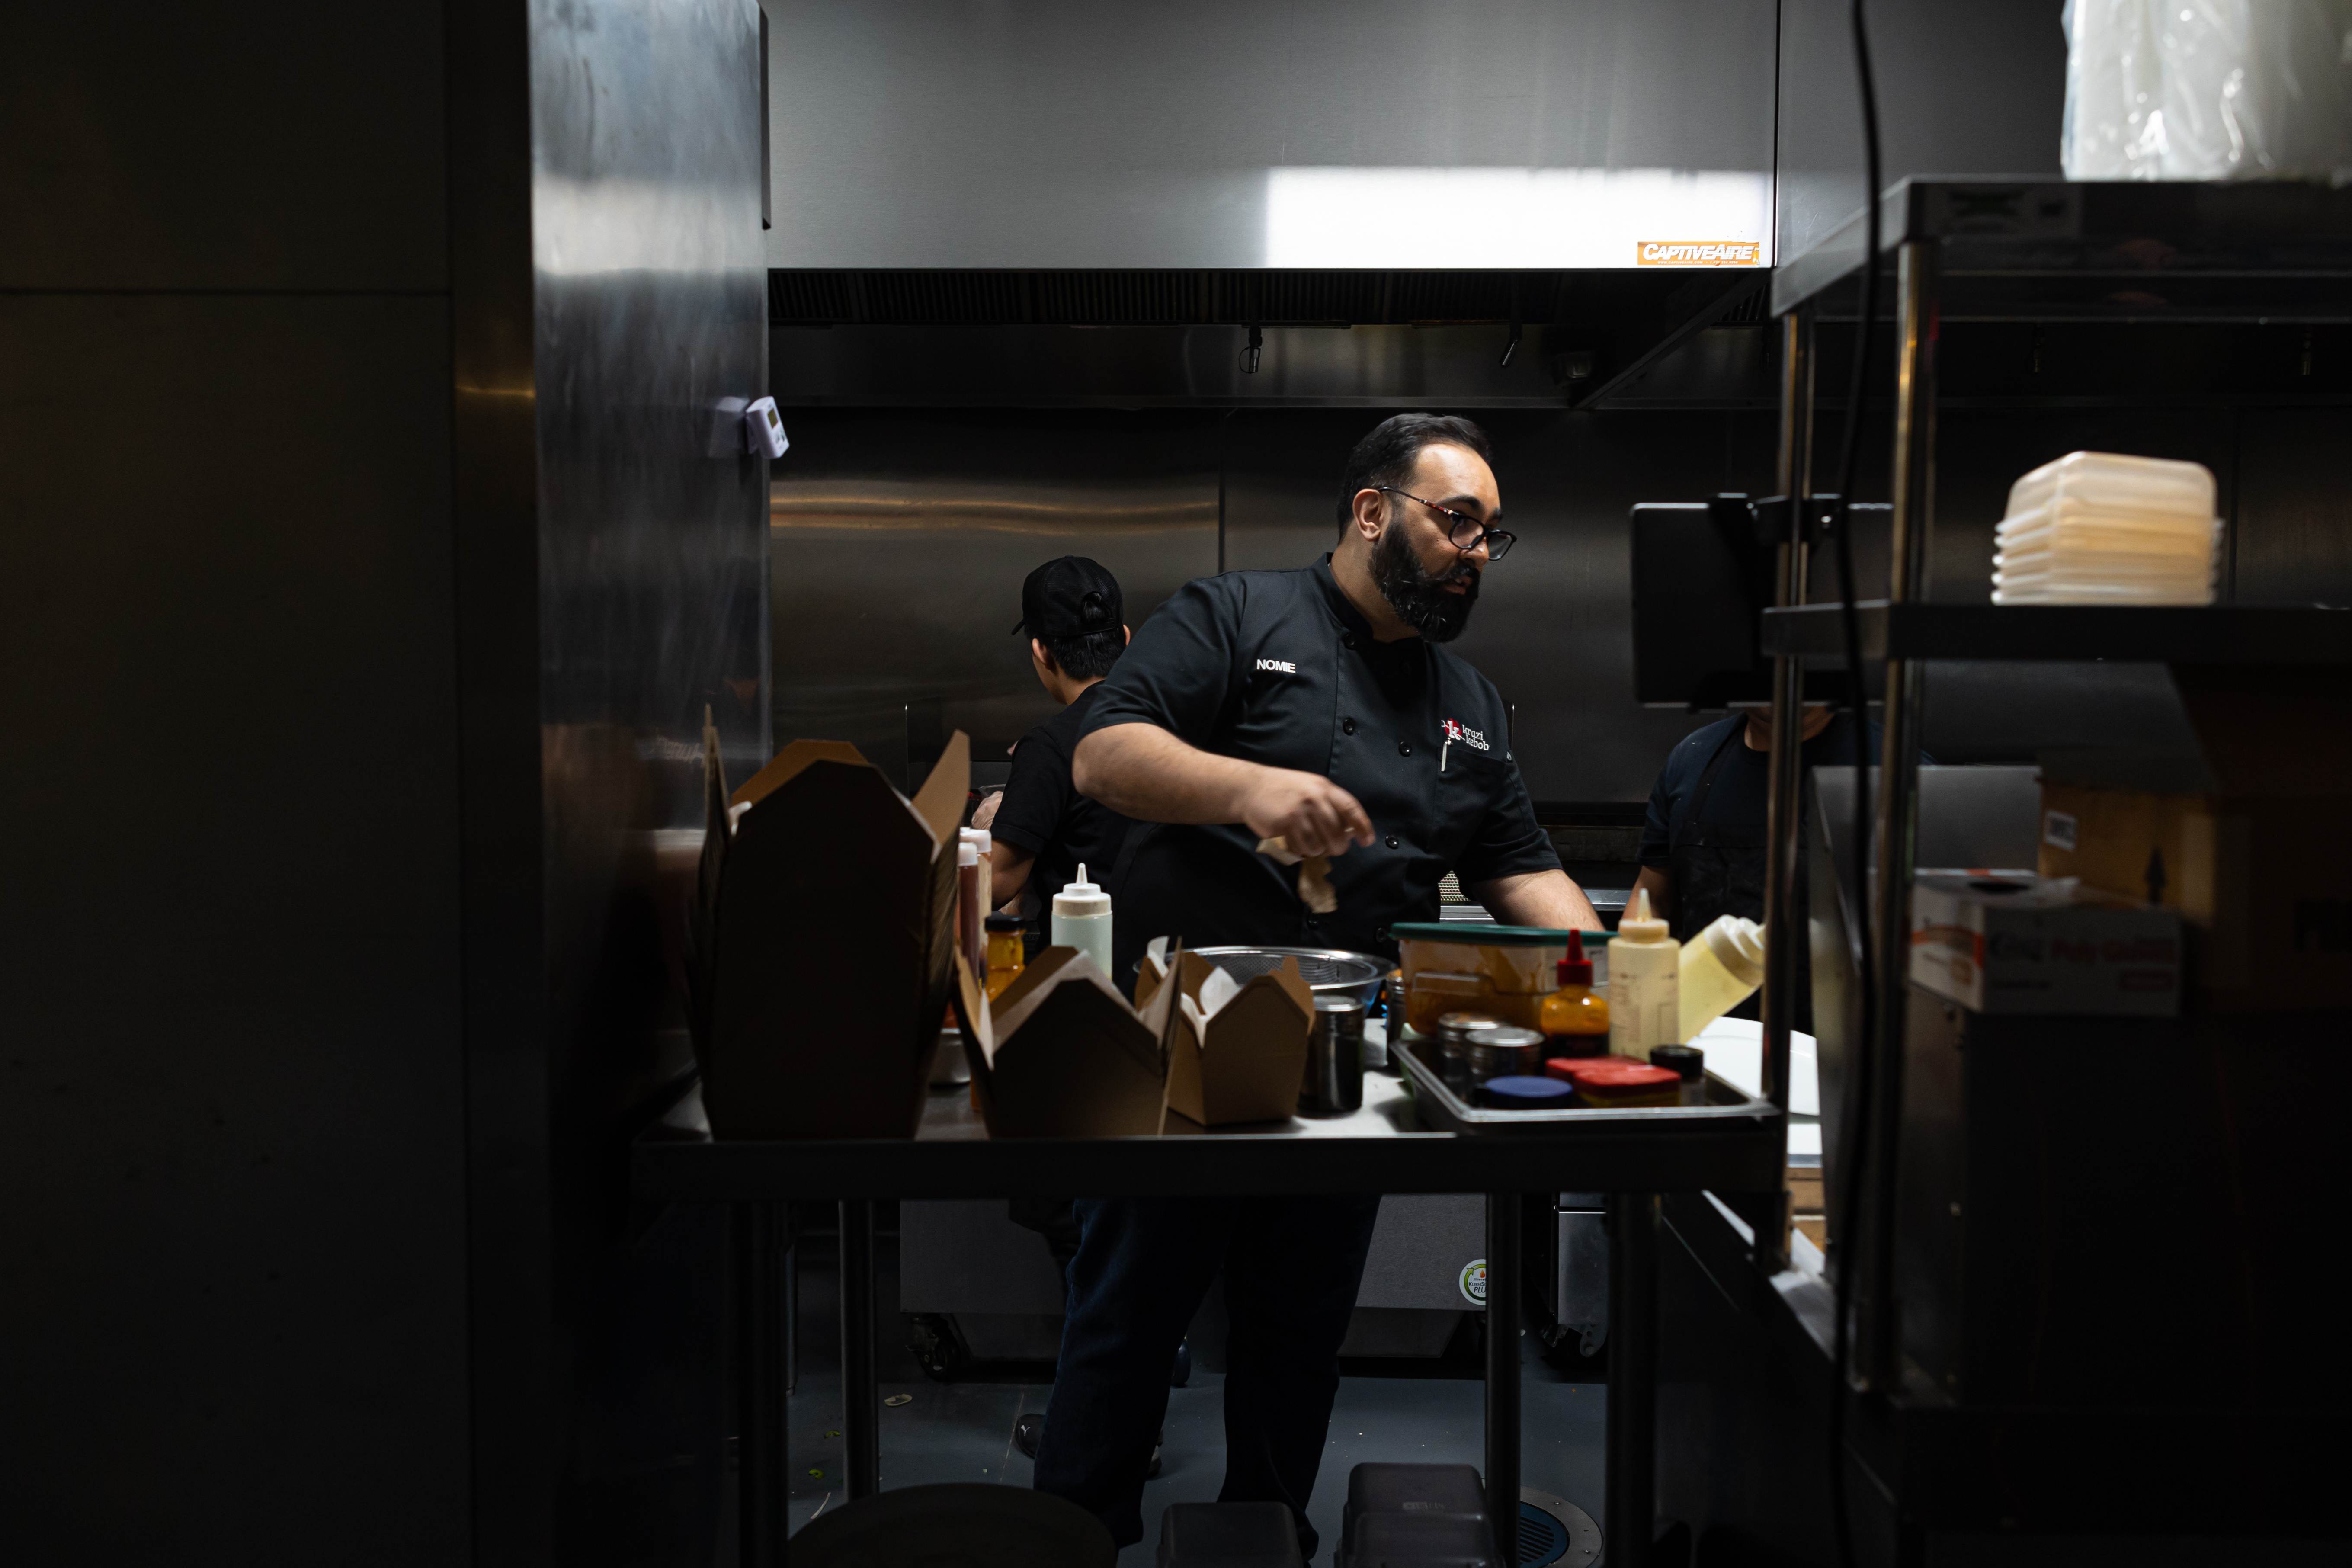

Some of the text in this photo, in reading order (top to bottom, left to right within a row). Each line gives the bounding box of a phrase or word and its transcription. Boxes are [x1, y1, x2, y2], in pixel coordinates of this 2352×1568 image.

[1256, 659, 1296, 673] NOMIE
[1462, 724, 1484, 741] krazi
[1465, 734, 1489, 750] kebob
